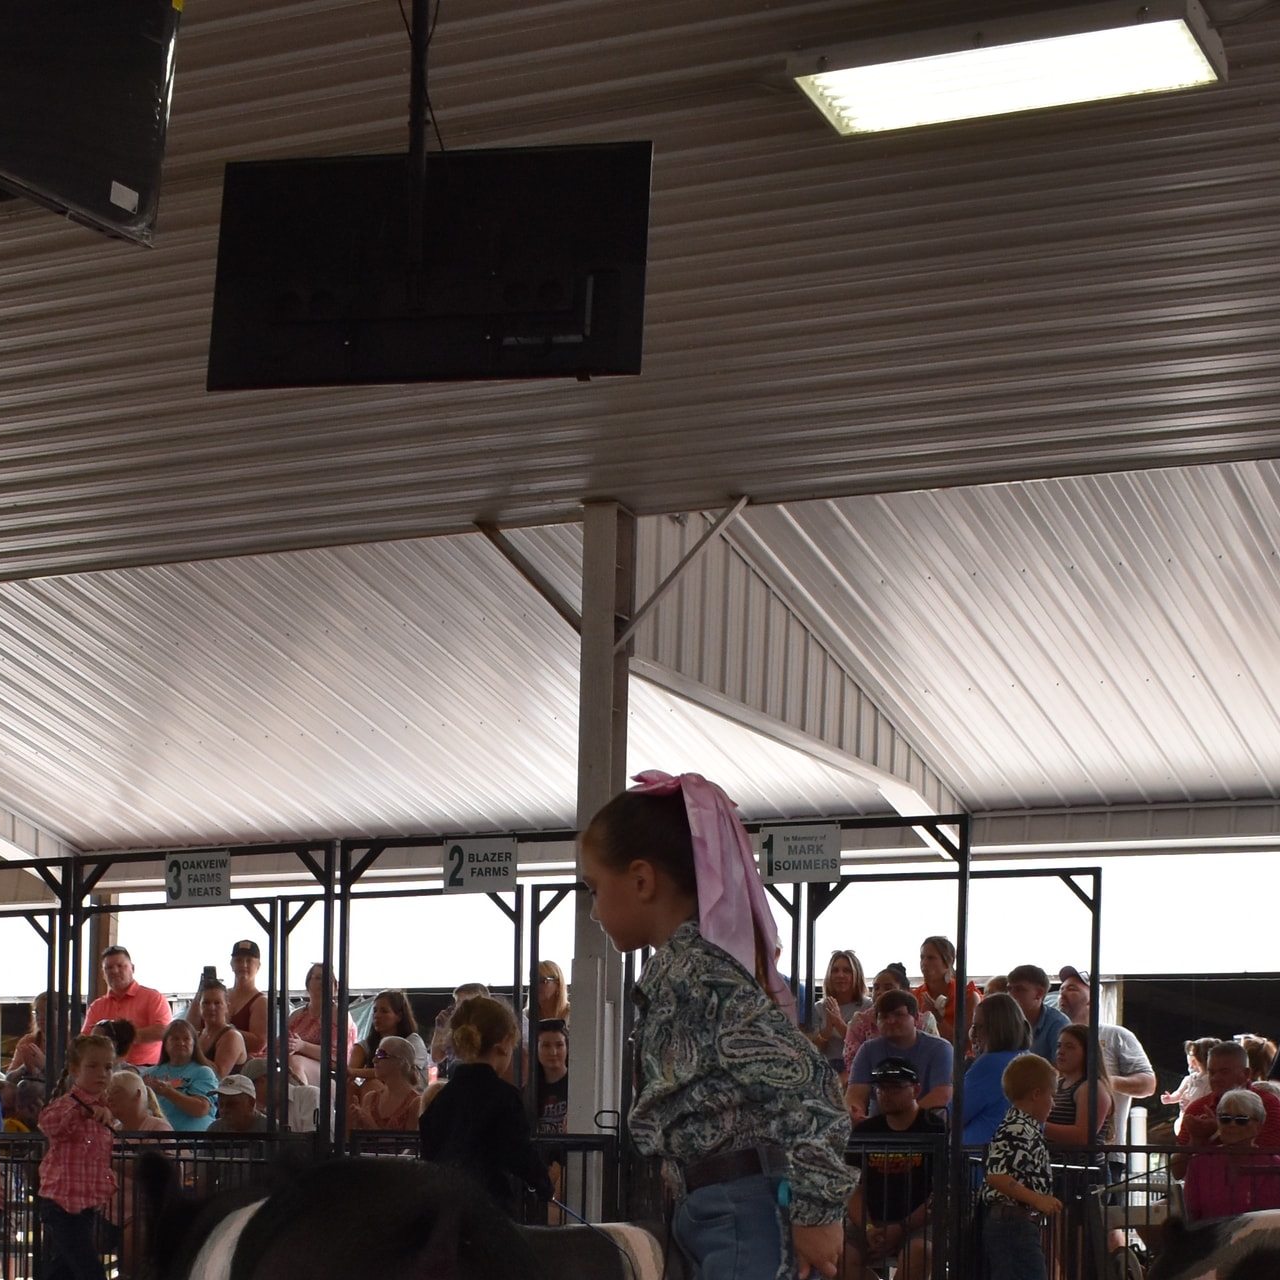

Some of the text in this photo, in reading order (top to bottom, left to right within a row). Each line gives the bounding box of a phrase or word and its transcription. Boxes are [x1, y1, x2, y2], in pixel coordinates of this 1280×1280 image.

[762, 834, 773, 876] 1
[788, 844, 824, 855] MARK
[468, 852, 512, 863] BLAZER
[182, 859, 228, 870] OAKVEIW
[449, 845, 464, 886] 2
[774, 859, 838, 871] SOMMERS
[471, 866, 509, 877] FARMS
[168, 860, 181, 900] 3
[187, 873, 222, 883] FARMS
[188, 886, 222, 897] MEATS
